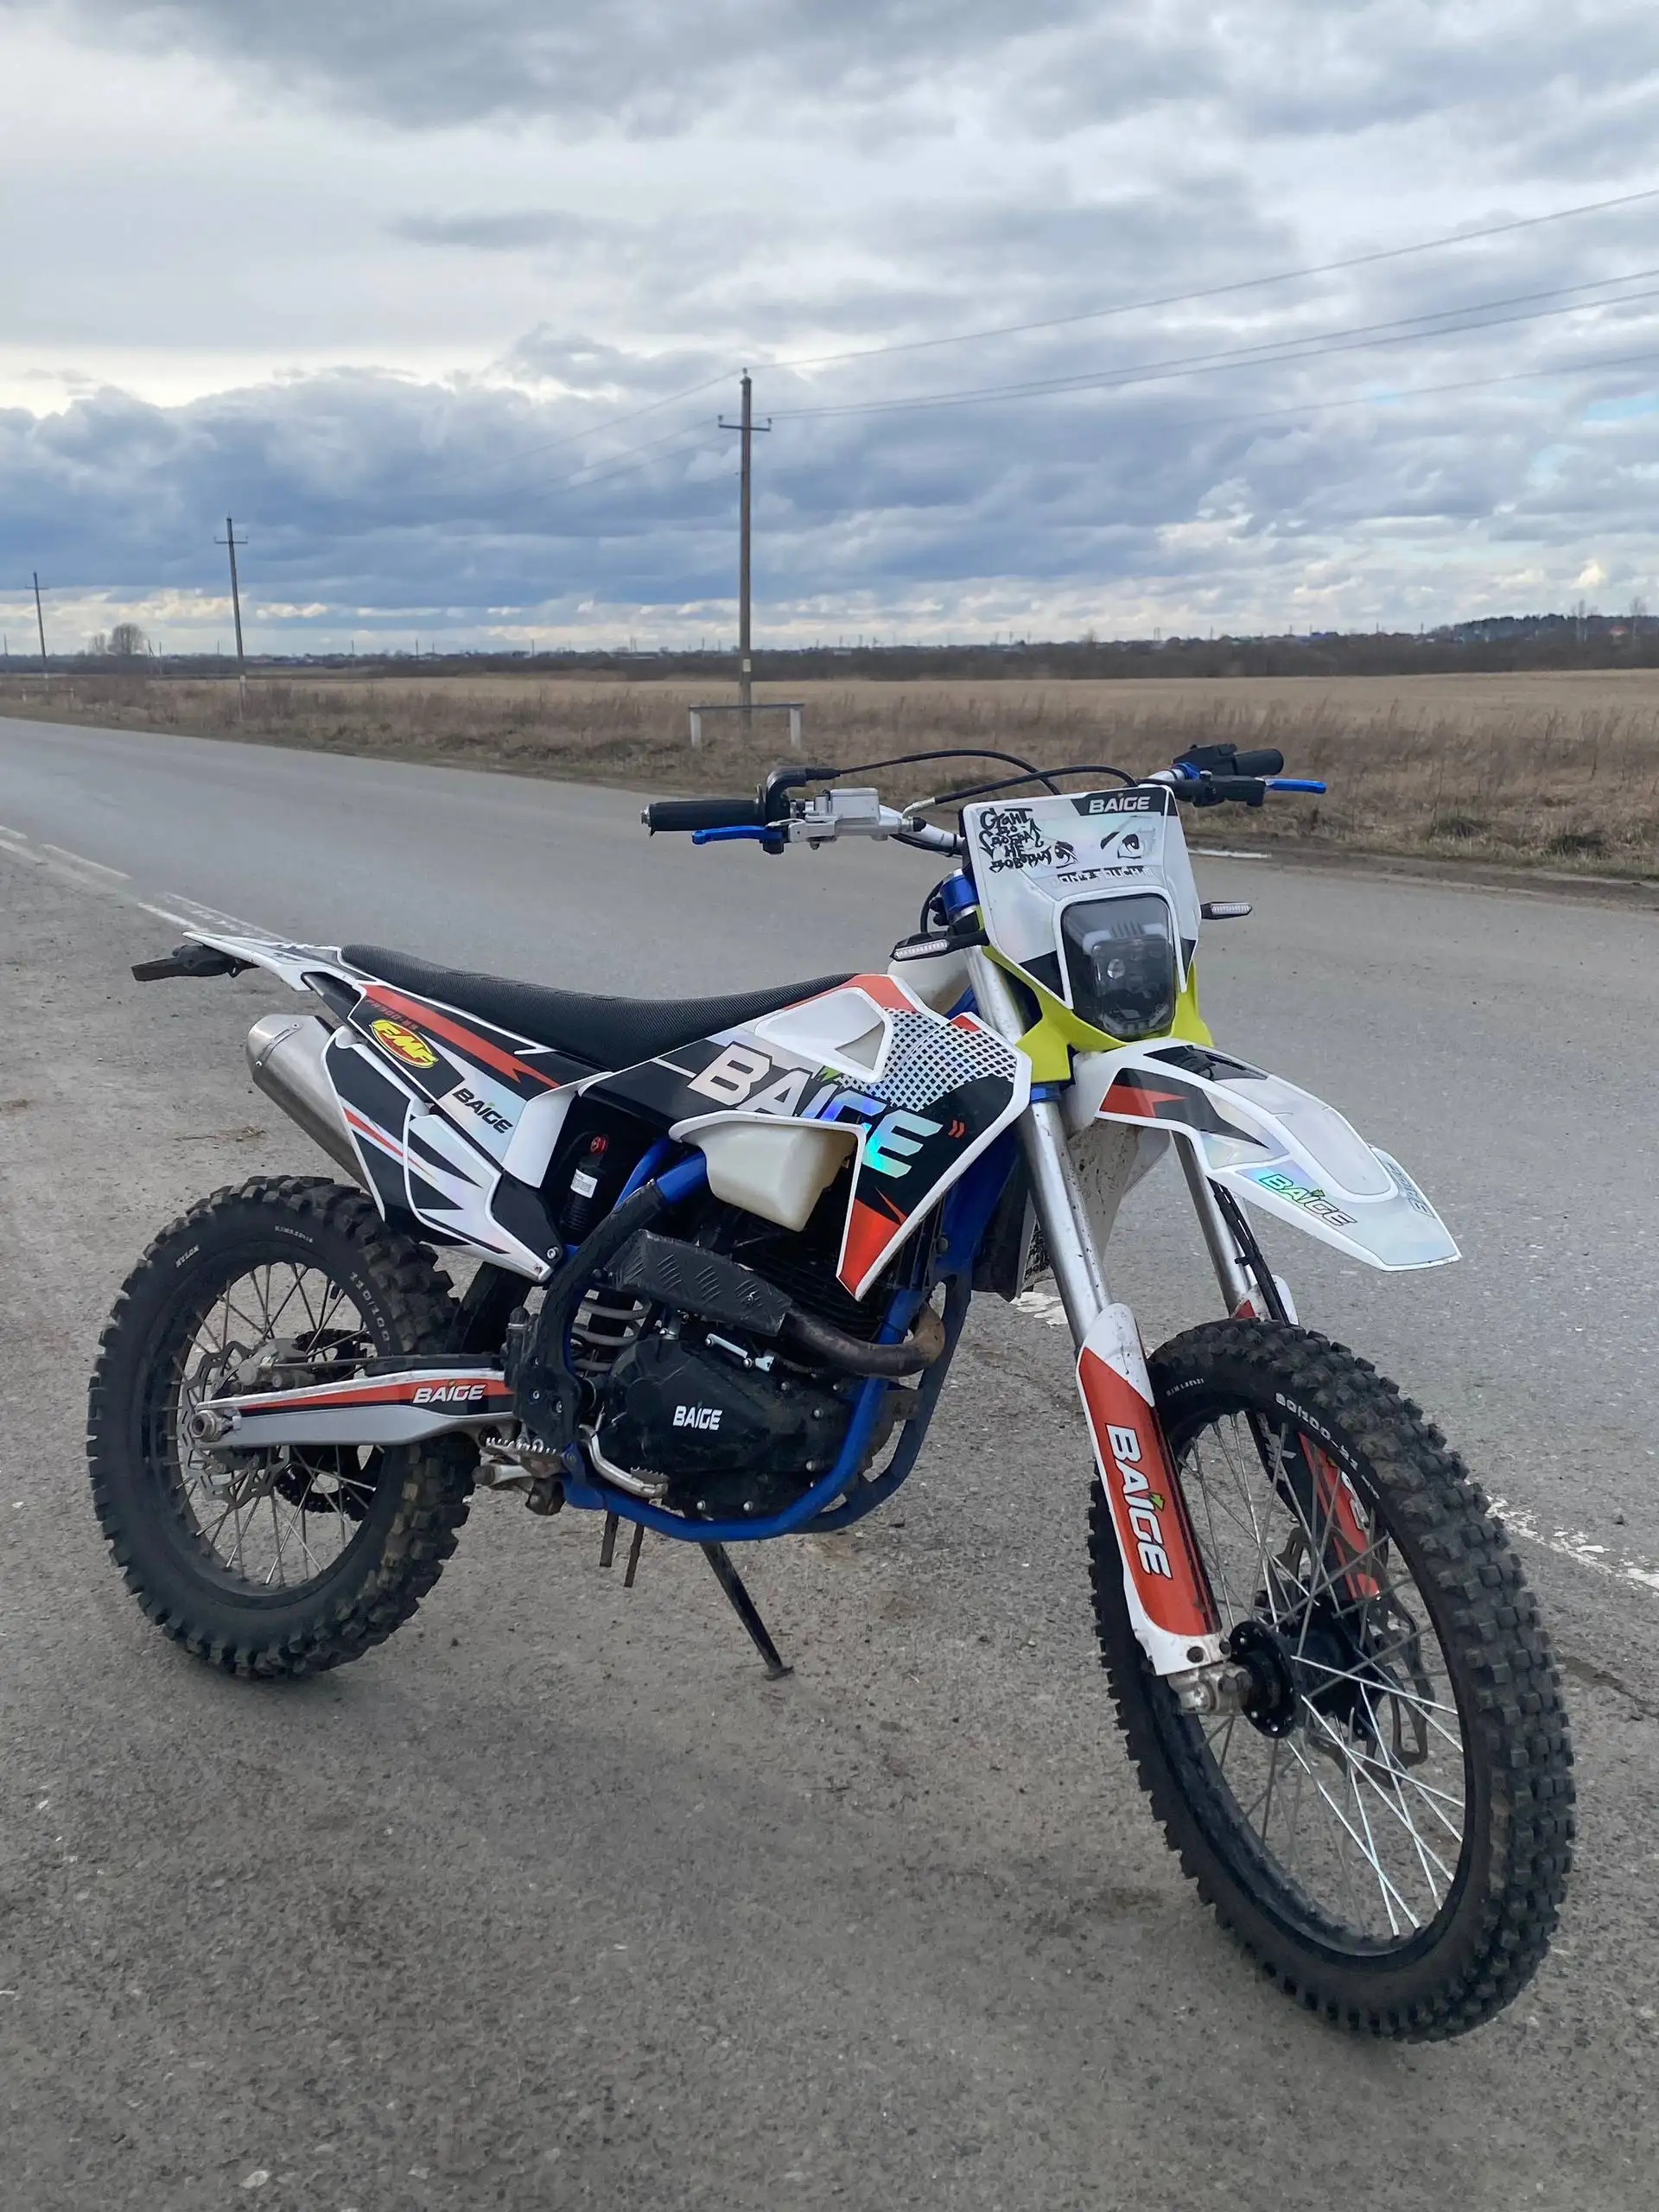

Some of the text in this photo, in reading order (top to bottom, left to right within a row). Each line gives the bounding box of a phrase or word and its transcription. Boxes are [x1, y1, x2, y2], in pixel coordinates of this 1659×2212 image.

[1089, 794, 1151, 813] BAIGE
[372, 1020, 439, 1063] FMF
[452, 1087, 514, 1134] BAIGE
[1258, 1173, 1357, 1226] BAIGE
[413, 1383, 486, 1404] BAIGE
[673, 1404, 723, 1431] BAIGE
[1105, 1423, 1173, 1580] BAIGE
